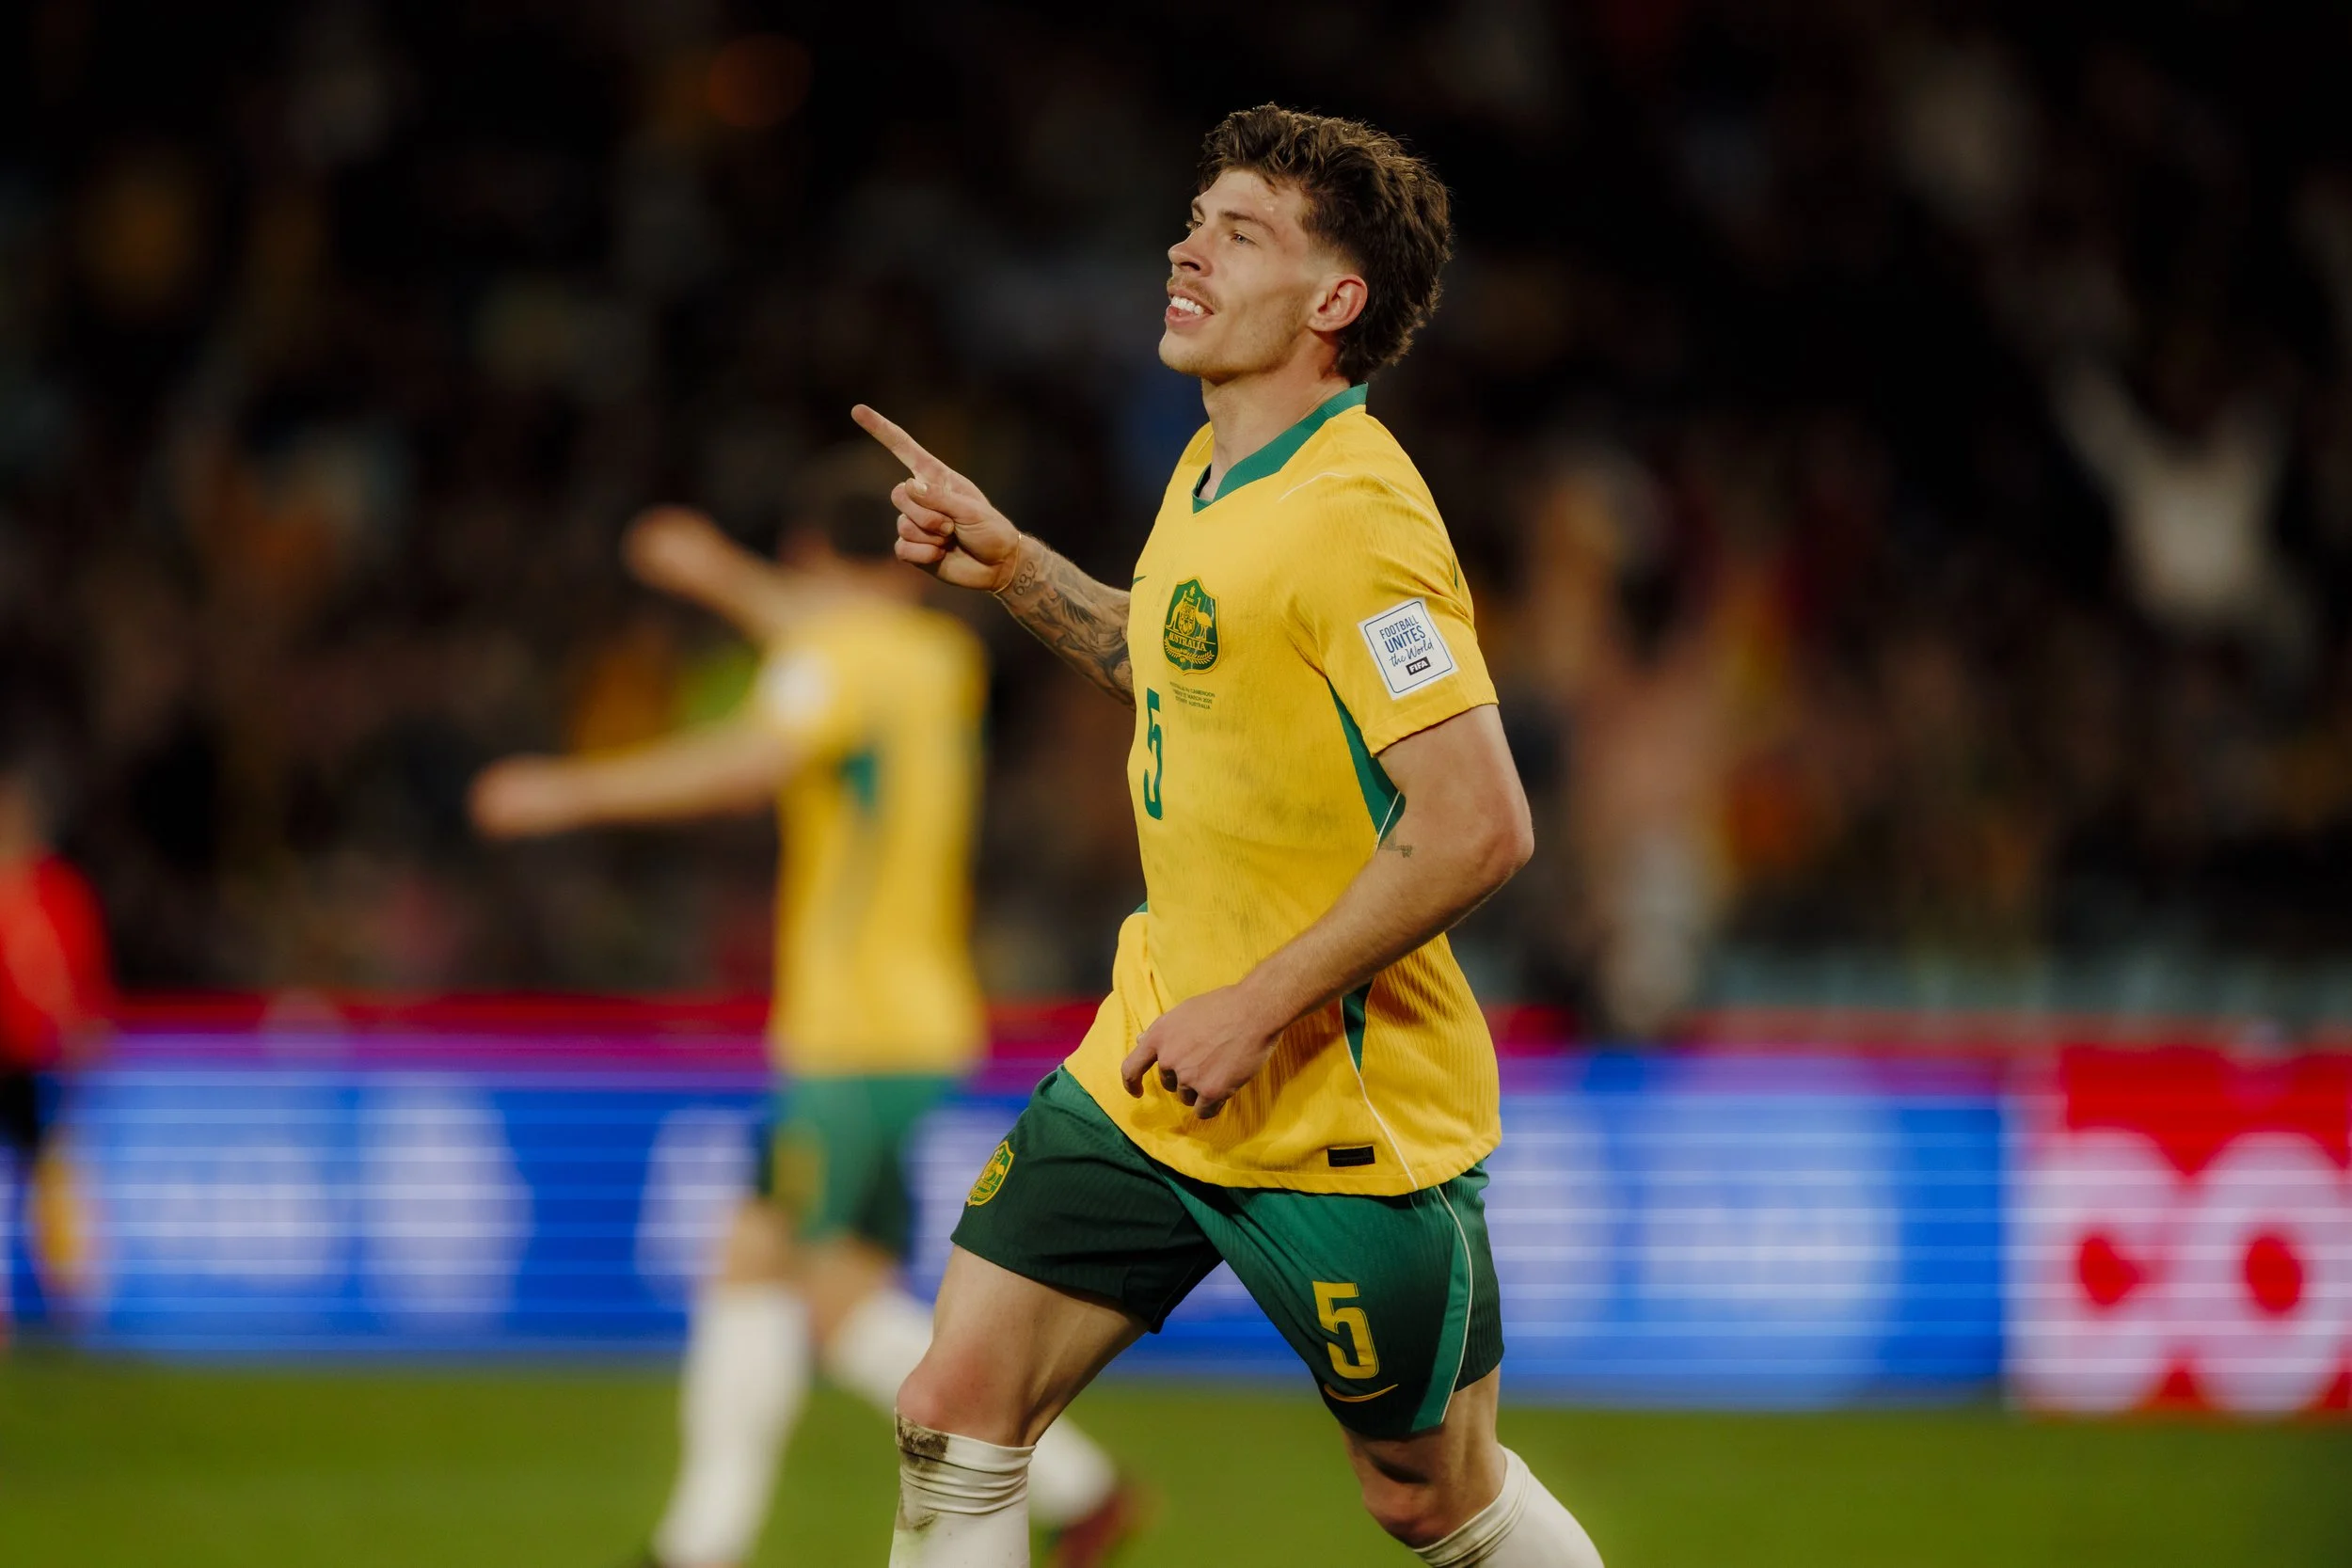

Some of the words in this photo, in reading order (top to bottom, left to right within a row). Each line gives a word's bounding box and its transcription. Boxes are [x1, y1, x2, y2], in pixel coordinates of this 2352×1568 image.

[1168, 631, 1206, 651] AUSTRALIA
[1379, 615, 1419, 640] FOOTBALL
[1384, 625, 1426, 654] UNITES
[1389, 654, 1406, 667] the
[1405, 638, 1434, 659] World
[1408, 659, 1428, 673] FIFA
[1143, 688, 1163, 820] 5
[1311, 1281, 1379, 1379] 5
